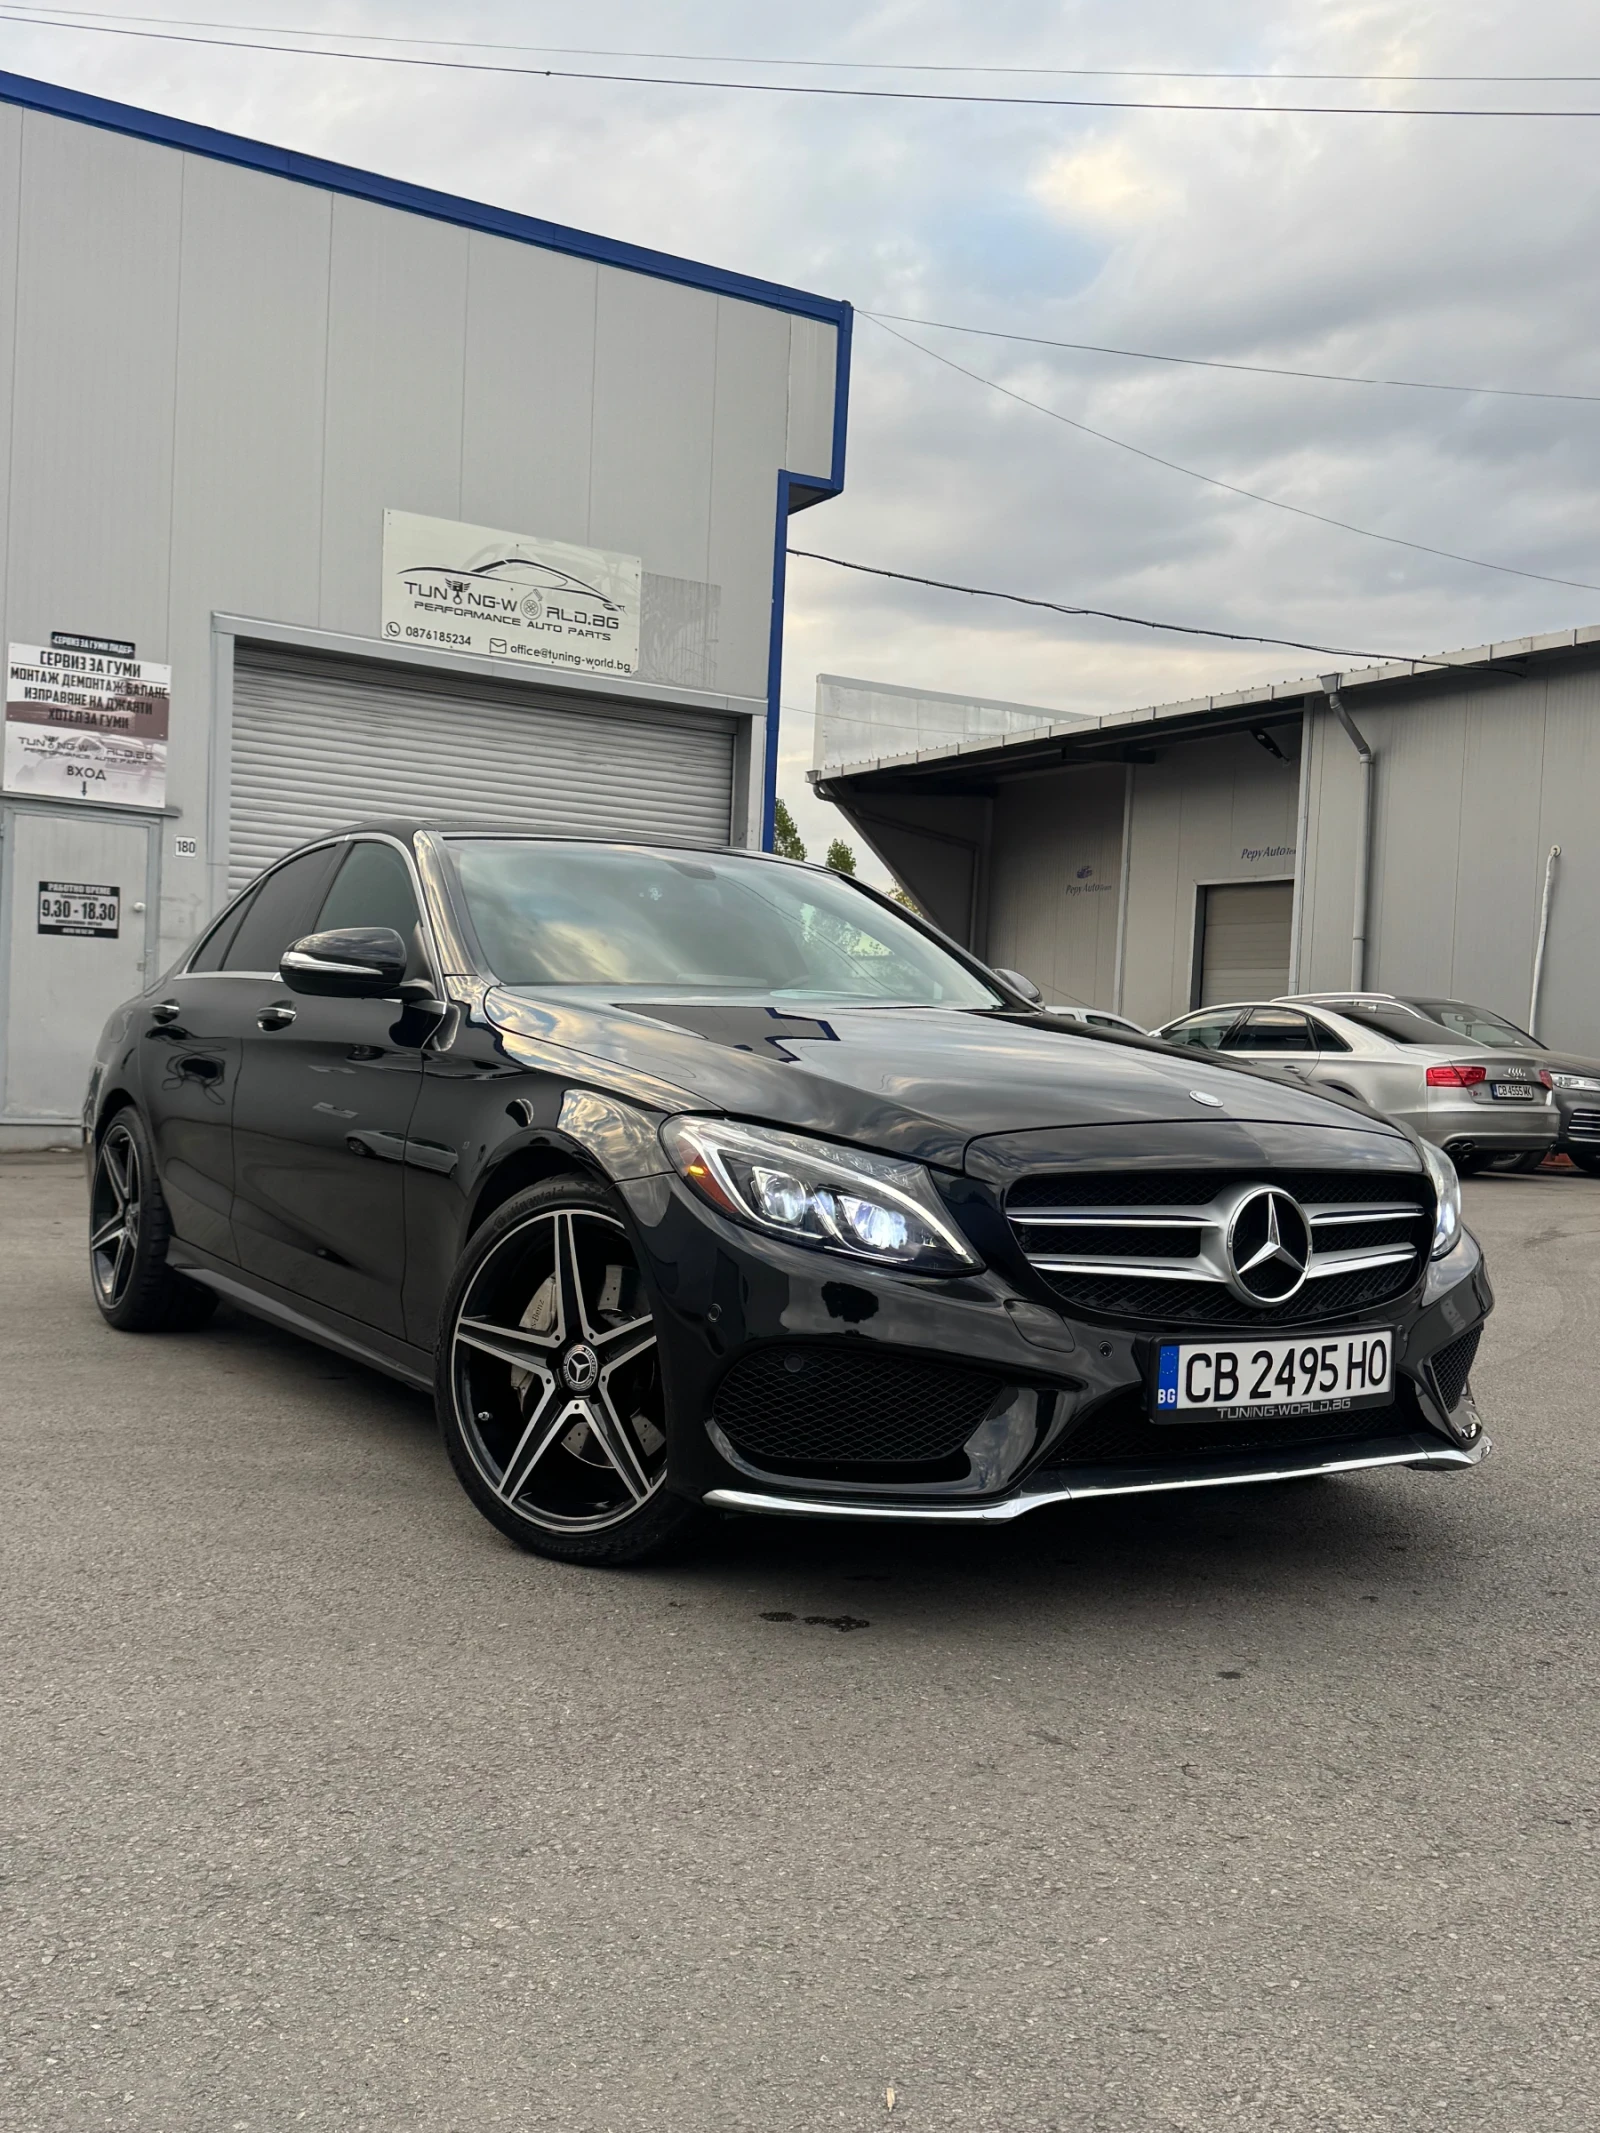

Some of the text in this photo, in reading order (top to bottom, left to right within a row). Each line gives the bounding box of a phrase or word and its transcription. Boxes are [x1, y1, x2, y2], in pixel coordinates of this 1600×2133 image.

[414, 601, 612, 641] PERFORMANCE AUTO PARTS
[405, 625, 472, 646] 0876185234
[40, 651, 141, 678] СЕРВИЗ ЗА ГУМИ
[510, 644, 631, 674] office@tuning-world.bg
[10, 667, 59, 685] МОНТАЖ
[62, 674, 125, 693] ДЕМОНТАЖ
[24, 686, 152, 715] ИЗПРАВЯНЕ НА ДЖАНТИ
[48, 707, 129, 729] ХОТЕЛ ЗА ГУМИ
[66, 765, 106, 780] ВХОД
[176, 841, 196, 853] 180
[42, 899, 71, 918] 9.30
[82, 902, 116, 921] 18.30
[1186, 1339, 1387, 1403] CB 2495 HO
[1157, 1388, 1176, 1404] BG
[1217, 1398, 1351, 1420] TUNING-WORLD.BG
